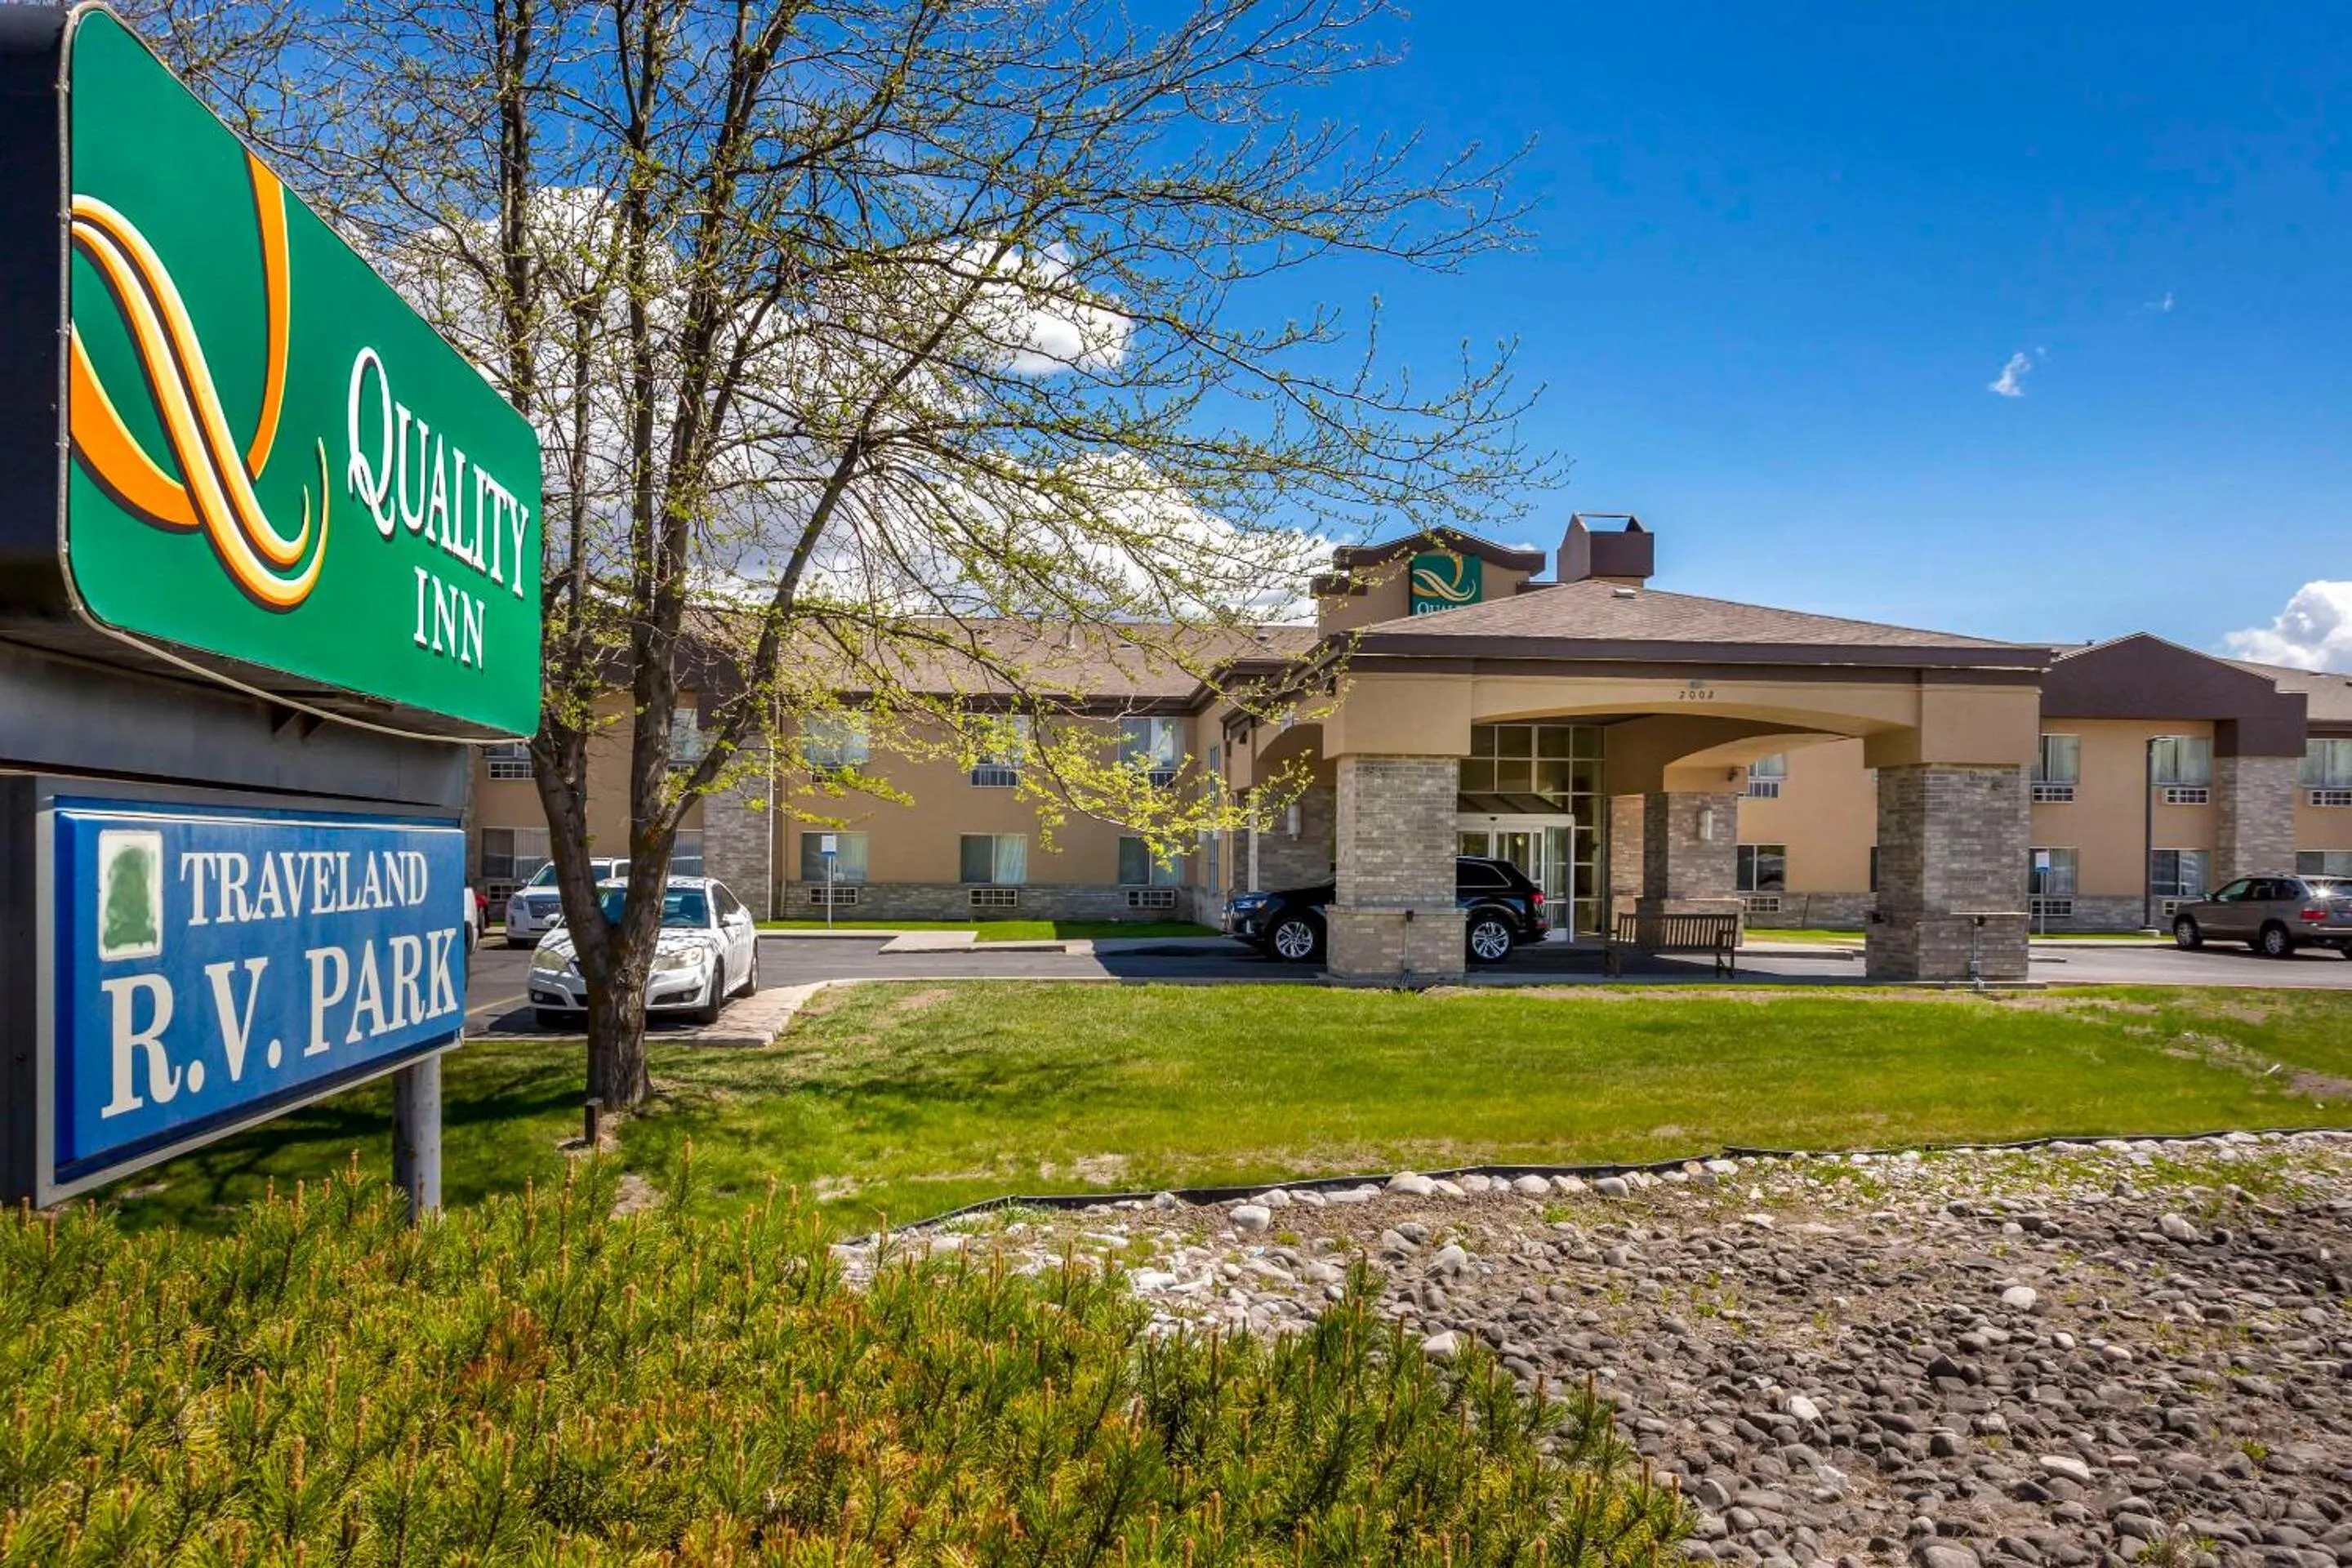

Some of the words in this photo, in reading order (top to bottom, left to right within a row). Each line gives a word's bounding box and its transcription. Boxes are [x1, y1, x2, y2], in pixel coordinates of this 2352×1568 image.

[347, 346, 529, 597] QUALITY
[413, 566, 485, 671] INN
[180, 850, 429, 926] TRAVELAND
[100, 956, 283, 1120] R.V.
[303, 927, 459, 1058] PARK
